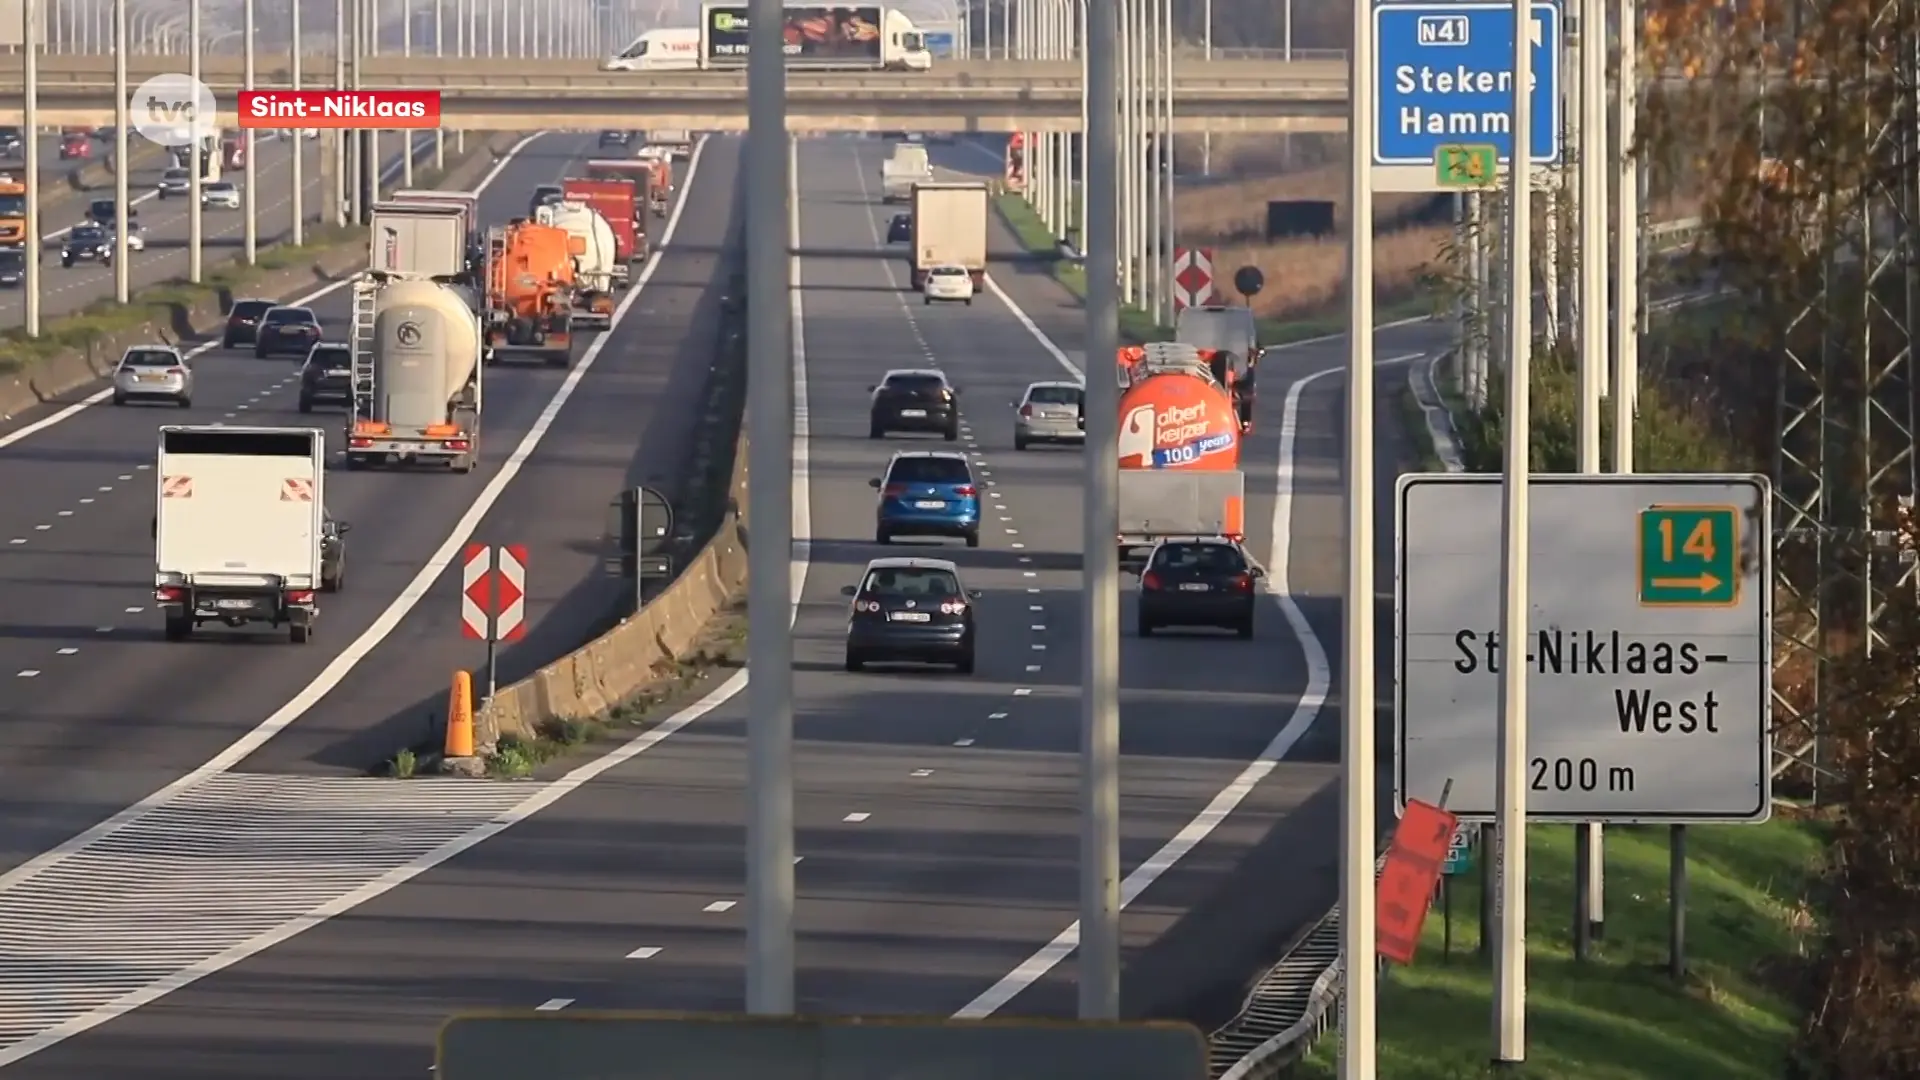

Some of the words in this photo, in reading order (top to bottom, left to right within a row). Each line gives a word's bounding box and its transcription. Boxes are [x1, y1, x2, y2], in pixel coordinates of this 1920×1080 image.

[1422, 20, 1465, 41] N41
[1157, 400, 1206, 427] albert
[1156, 420, 1211, 445] keijzer
[1163, 446, 1193, 462] 100
[1199, 433, 1232, 452] years
[1658, 518, 1715, 562] 14
[1615, 688, 1719, 733] West
[1531, 757, 1598, 791] 200
[1609, 767, 1635, 791] m
